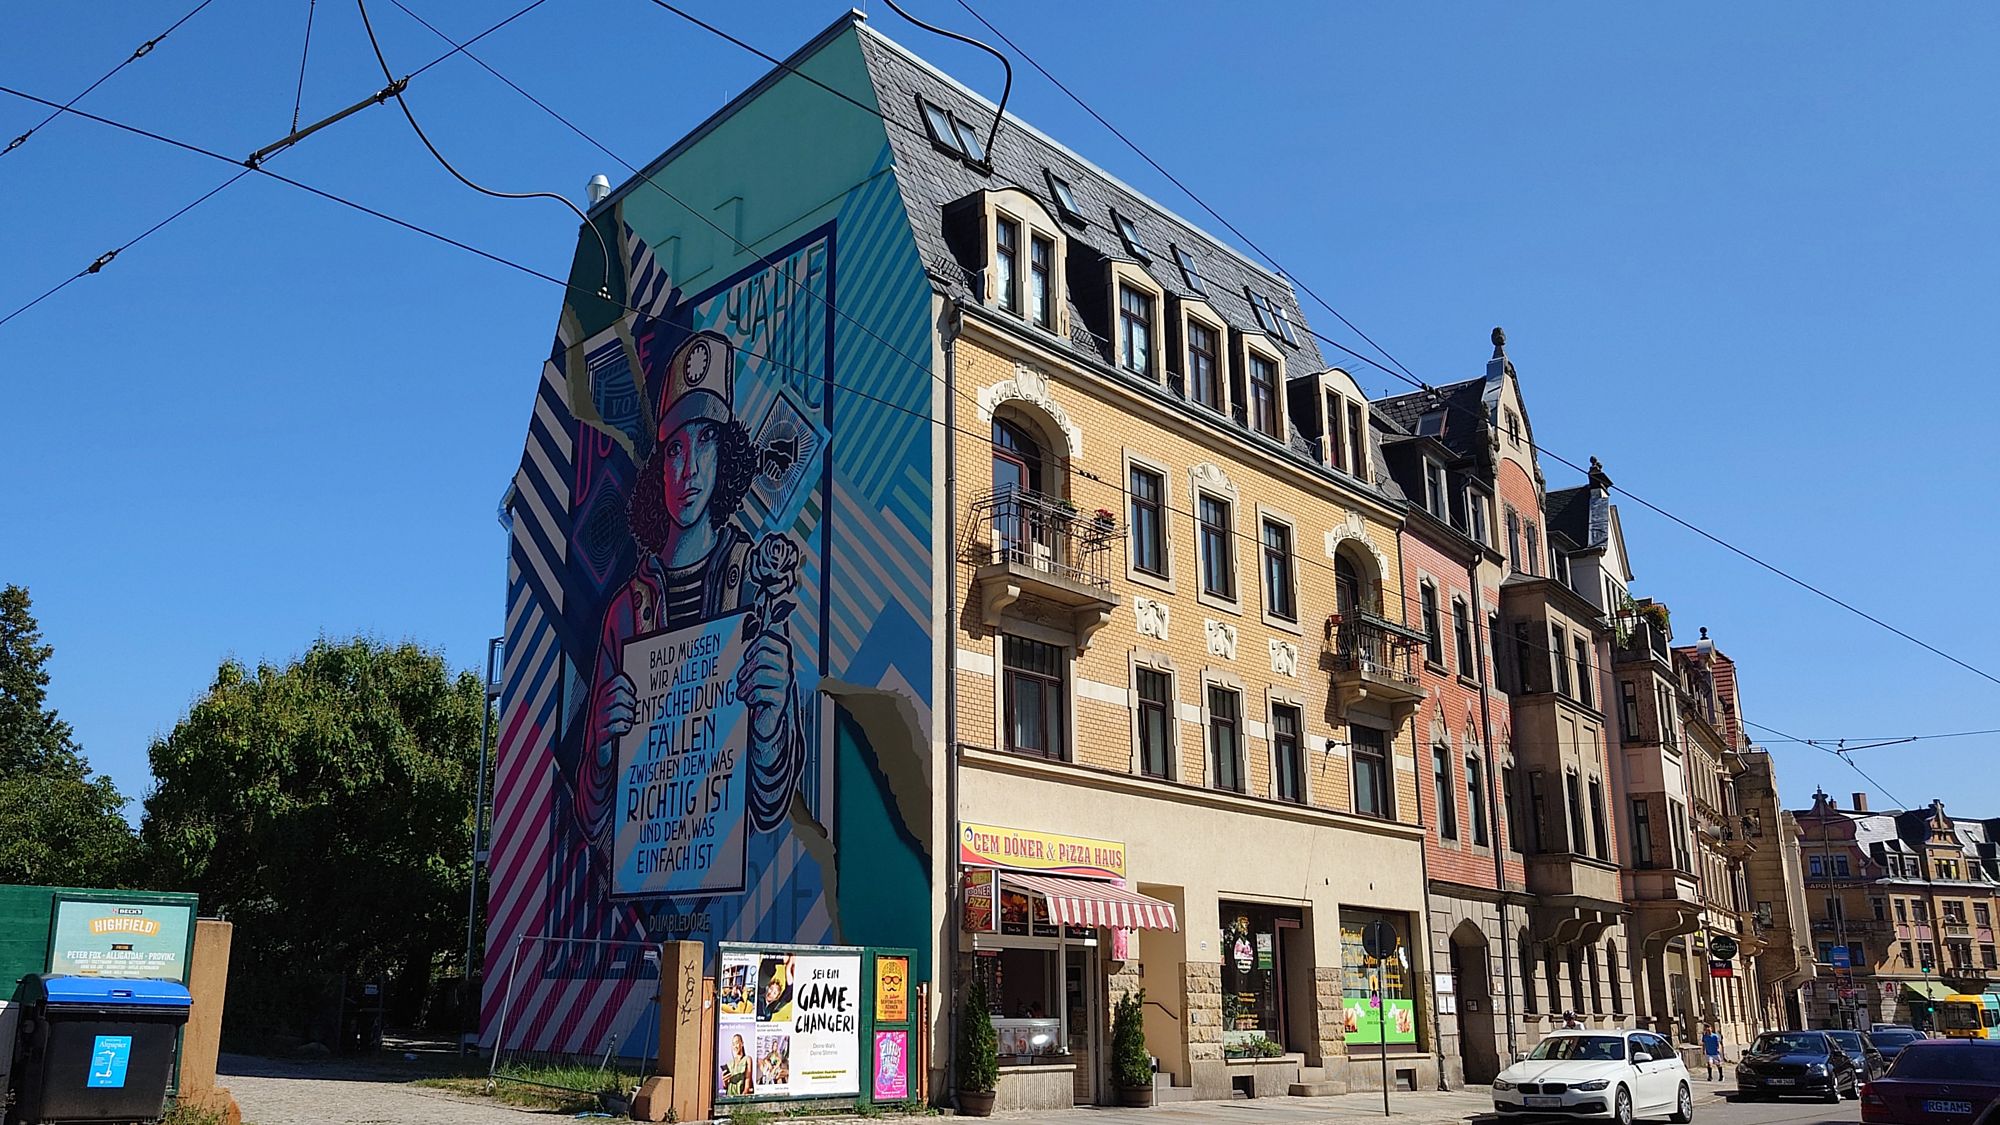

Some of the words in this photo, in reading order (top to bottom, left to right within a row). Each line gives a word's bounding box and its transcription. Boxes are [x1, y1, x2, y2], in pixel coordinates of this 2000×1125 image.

[650, 644, 675, 669] BALD
[678, 632, 720, 662] MÜSSEN
[650, 669, 669, 691] WIR
[671, 662, 698, 685] ALLE
[700, 656, 719, 679] DIE
[634, 680, 735, 725] ENTSCHEIDUNG
[648, 714, 716, 760] FÄLLEN
[629, 758, 680, 785] ZWISCHEN
[711, 749, 734, 771] WAS
[627, 779, 697, 823] RICHTIG
[705, 774, 732, 814] IST
[639, 823, 662, 844] UND
[692, 816, 715, 838] WAS
[637, 850, 692, 874] EINFACH
[693, 843, 713, 869] IST
[974, 833, 1000, 855] CEM
[1004, 833, 1044, 859] DÖNER
[1046, 842, 1056, 861] &
[1094, 847, 1122, 868] HAUS
[649, 912, 711, 933] DUMBLEDORE
[812, 968, 824, 980] SEI
[827, 968, 839, 979] EIN
[798, 983, 852, 1012] GAME-
[795, 1012, 854, 1034] CHANGER!
